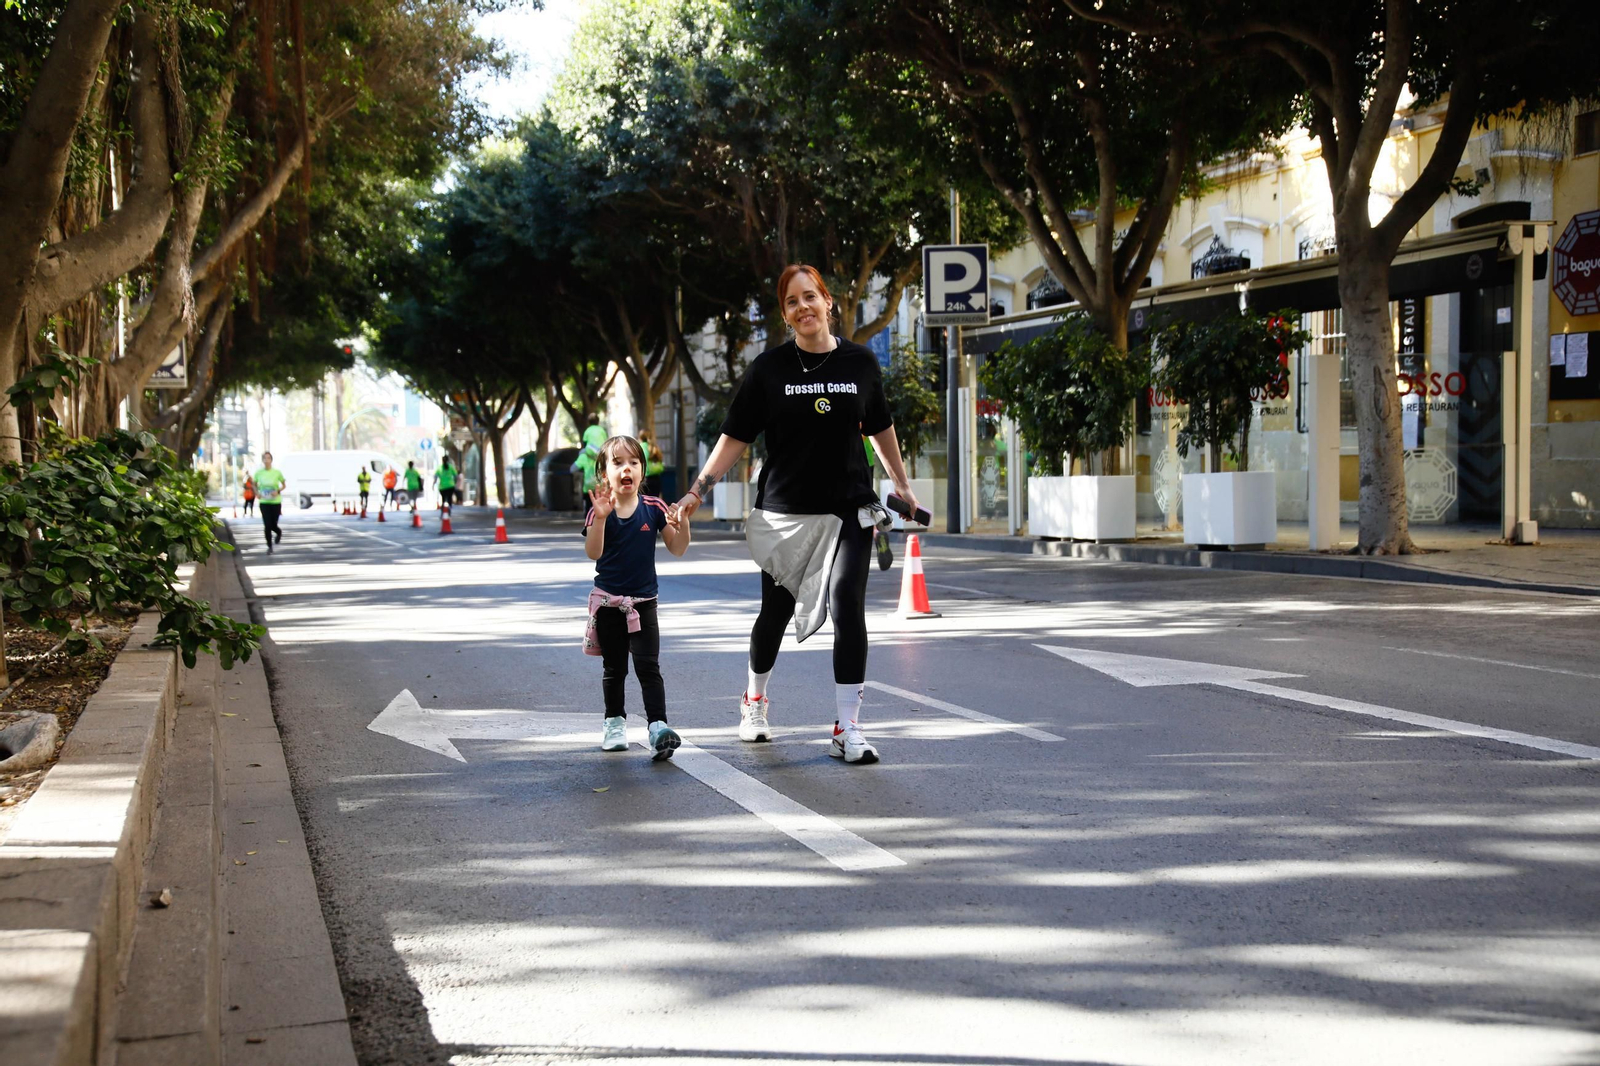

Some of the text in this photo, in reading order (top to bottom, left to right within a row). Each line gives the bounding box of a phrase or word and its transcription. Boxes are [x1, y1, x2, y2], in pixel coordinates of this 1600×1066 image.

[929, 251, 982, 312] P
[946, 302, 966, 312] 24h
[827, 382, 858, 394] Coach
[1397, 372, 1467, 396] OSSO
[1406, 401, 1462, 413] RESTAURAN
